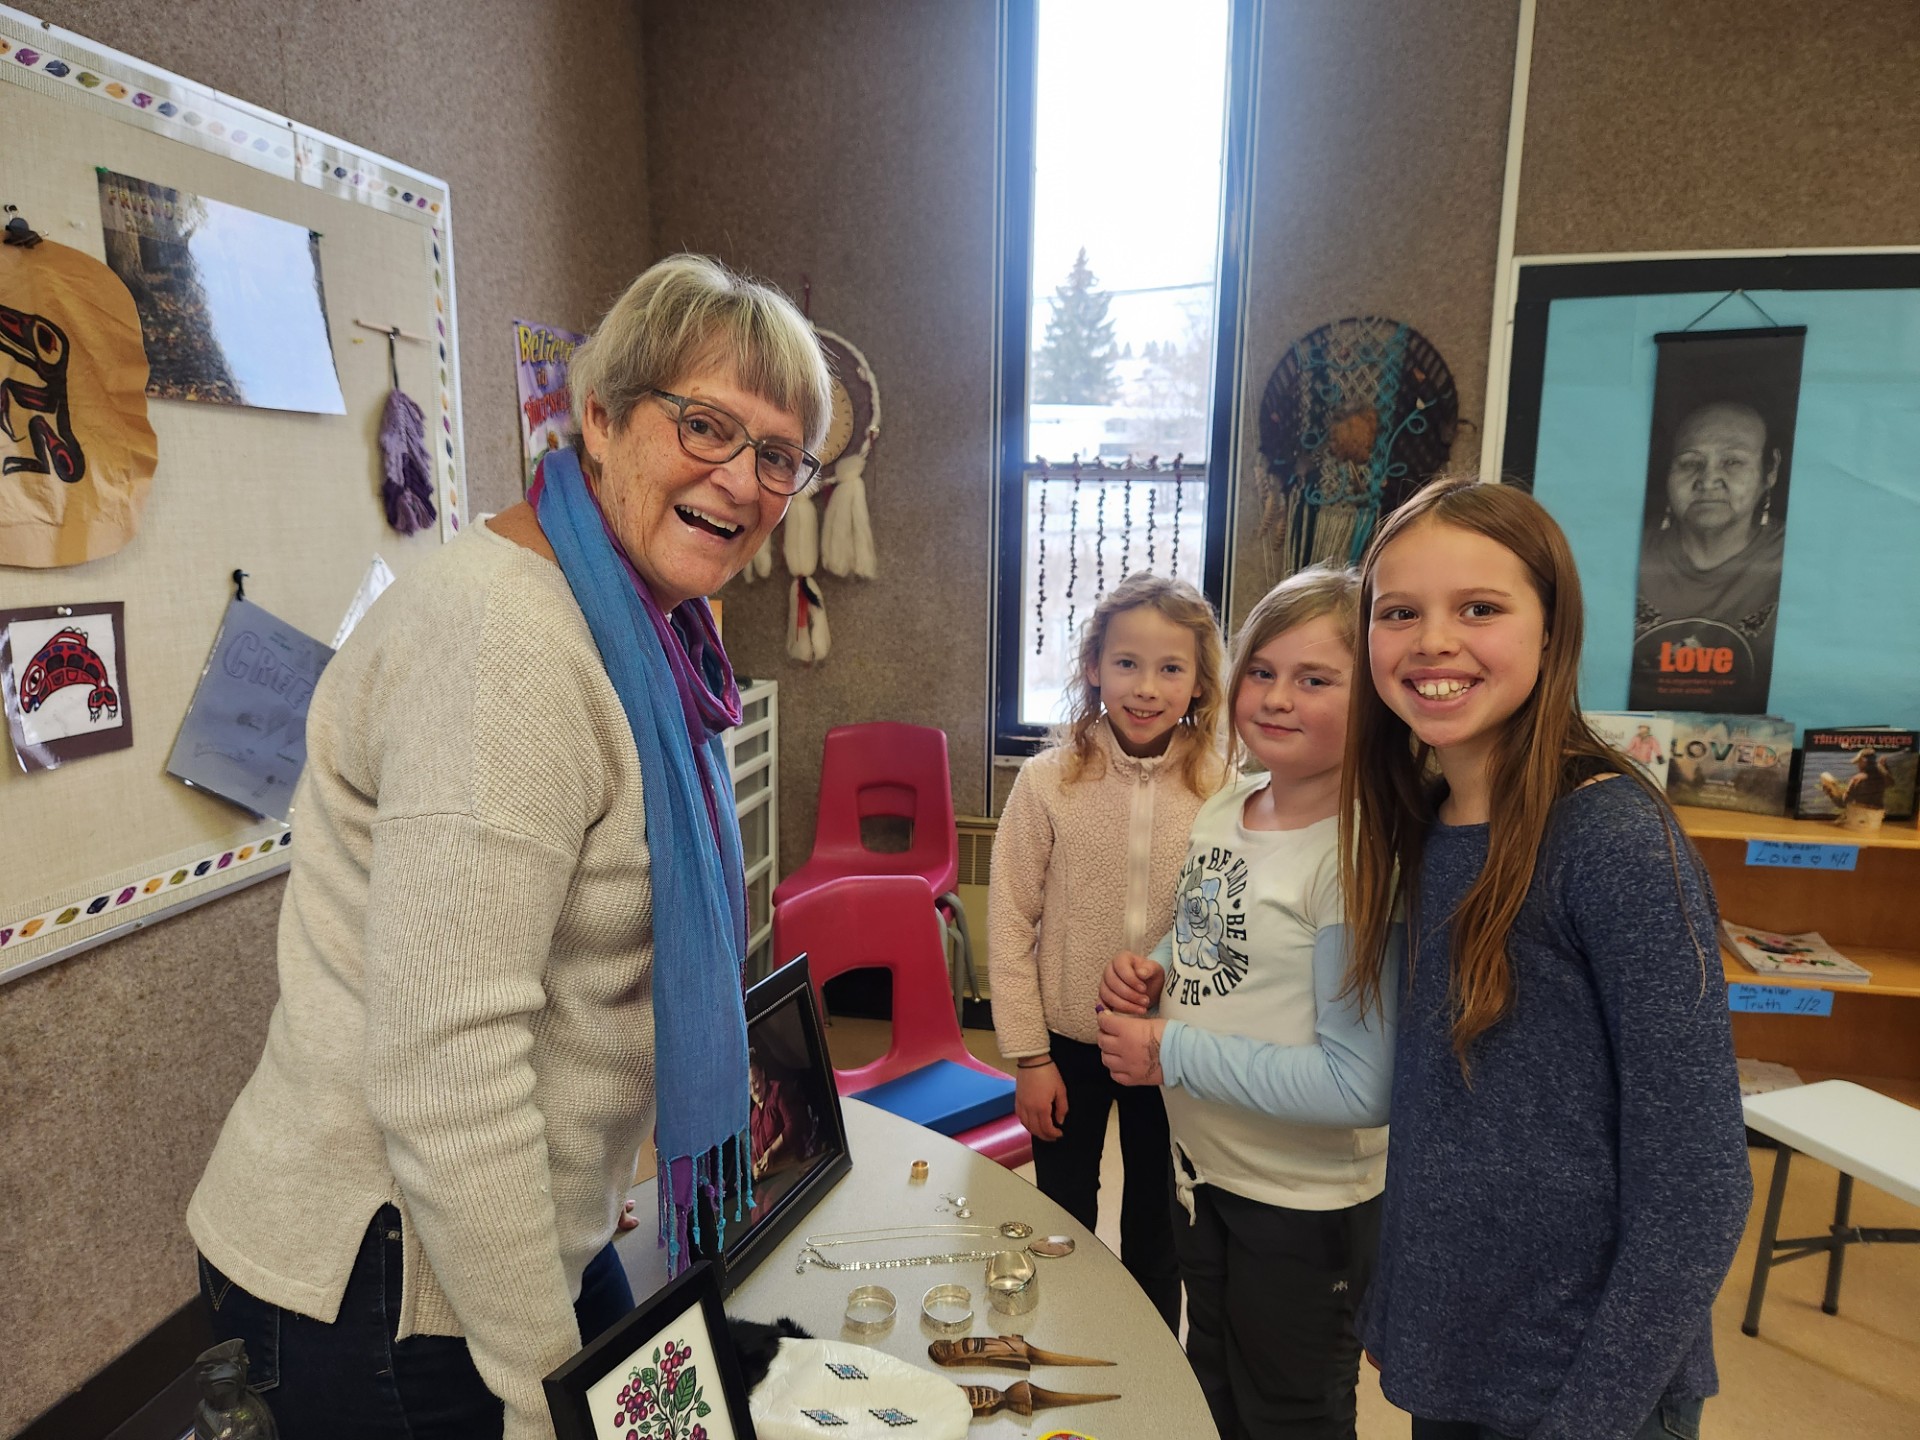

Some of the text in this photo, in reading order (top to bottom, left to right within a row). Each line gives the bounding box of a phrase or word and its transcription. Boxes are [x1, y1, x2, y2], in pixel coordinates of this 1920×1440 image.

[1660, 641, 1734, 673] Love
[1671, 738, 1778, 768] LOVED
[1206, 847, 1232, 872] BE
[1212, 913, 1249, 997] BE KIND
[1180, 978, 1201, 1006] BE
